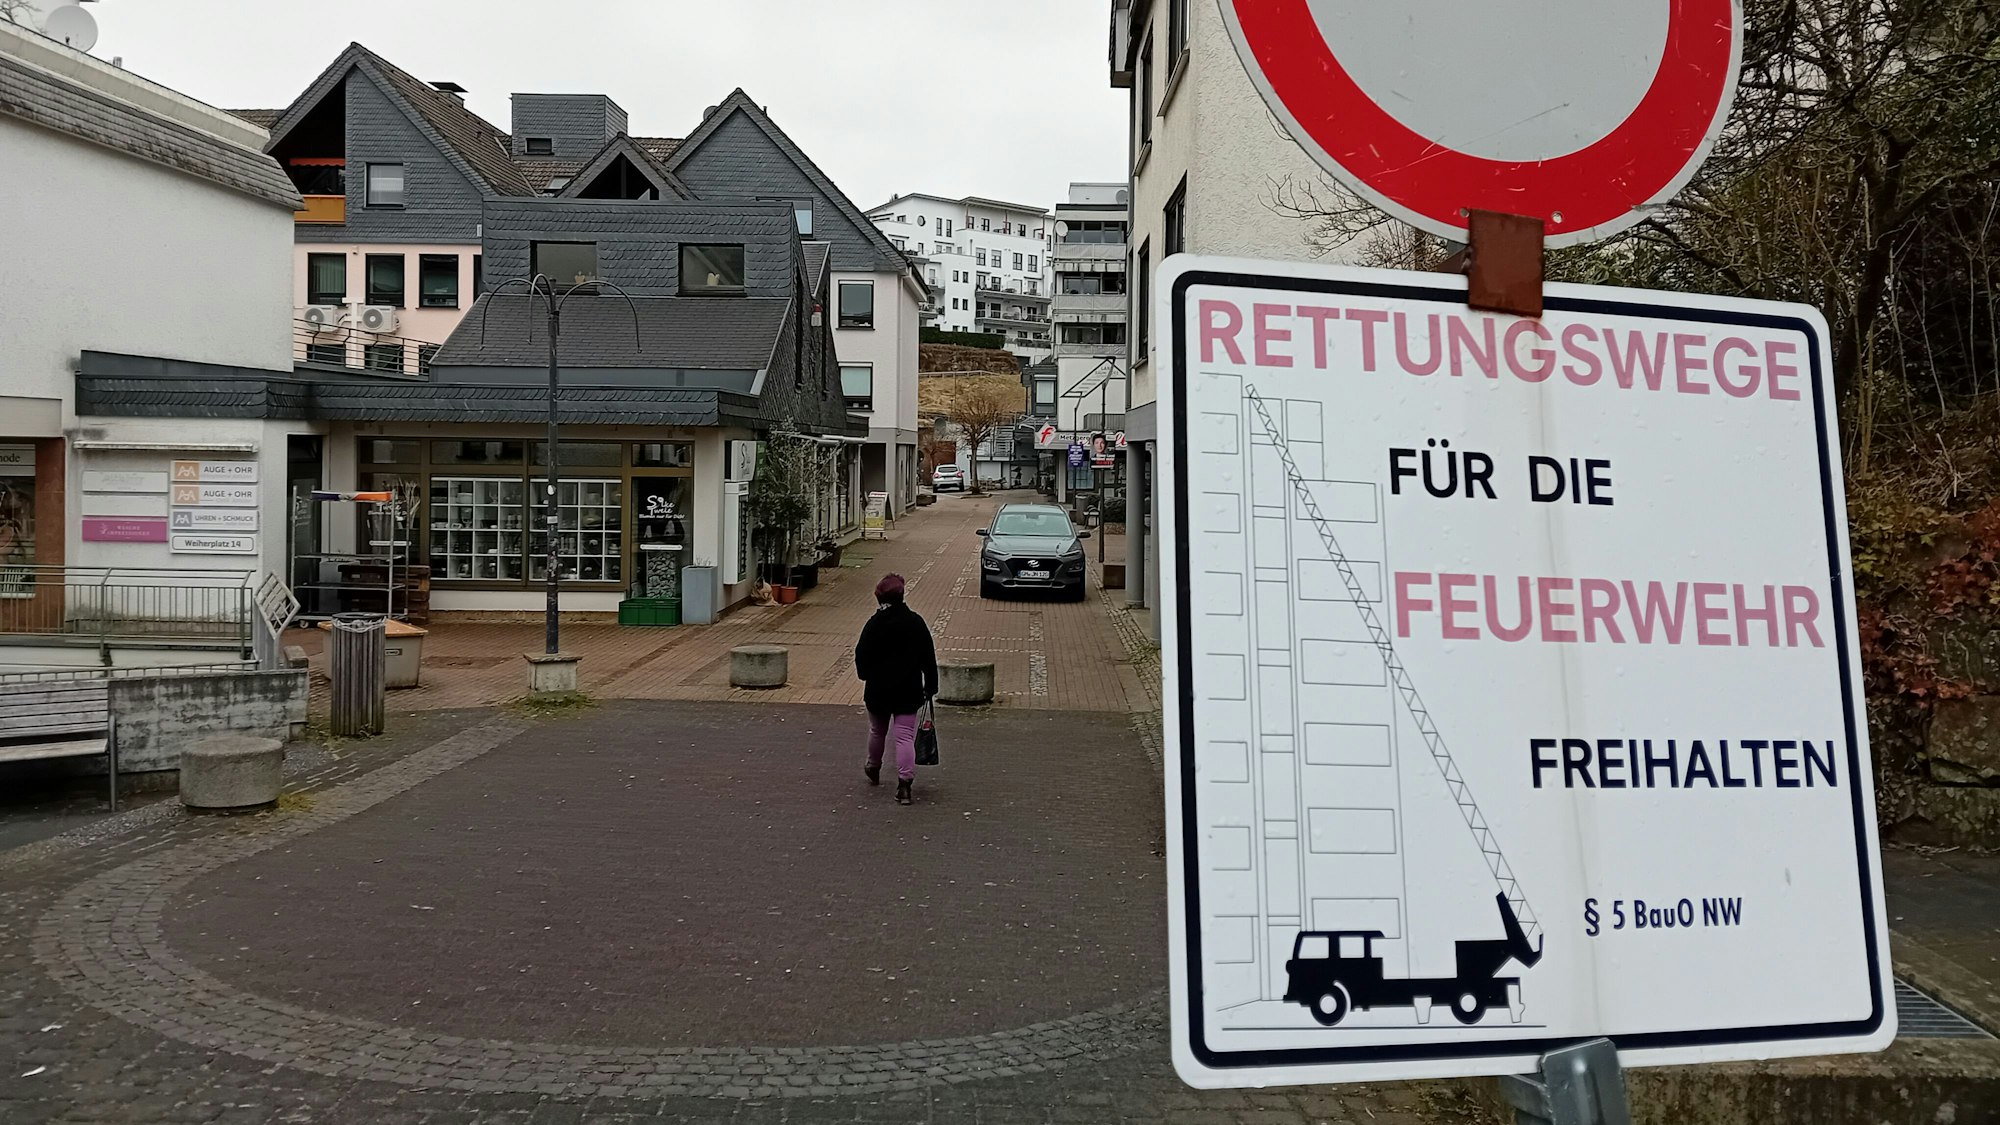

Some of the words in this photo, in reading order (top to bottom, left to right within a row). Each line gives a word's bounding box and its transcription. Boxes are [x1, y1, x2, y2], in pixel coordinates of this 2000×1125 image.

[1200, 299, 1801, 401] RETTUNGSWEGE
[1389, 438, 1498, 500] FÜR
[1530, 455, 1614, 506] DIE
[184, 540, 229, 548] Weiherplatz
[1394, 571, 1824, 647] FEUERWEHR
[1530, 738, 1838, 789] FREIHALTEN
[1584, 898, 1600, 937] §
[1613, 900, 1626, 930] 5
[1634, 898, 1695, 928] BauO
[1702, 897, 1742, 927] NW
